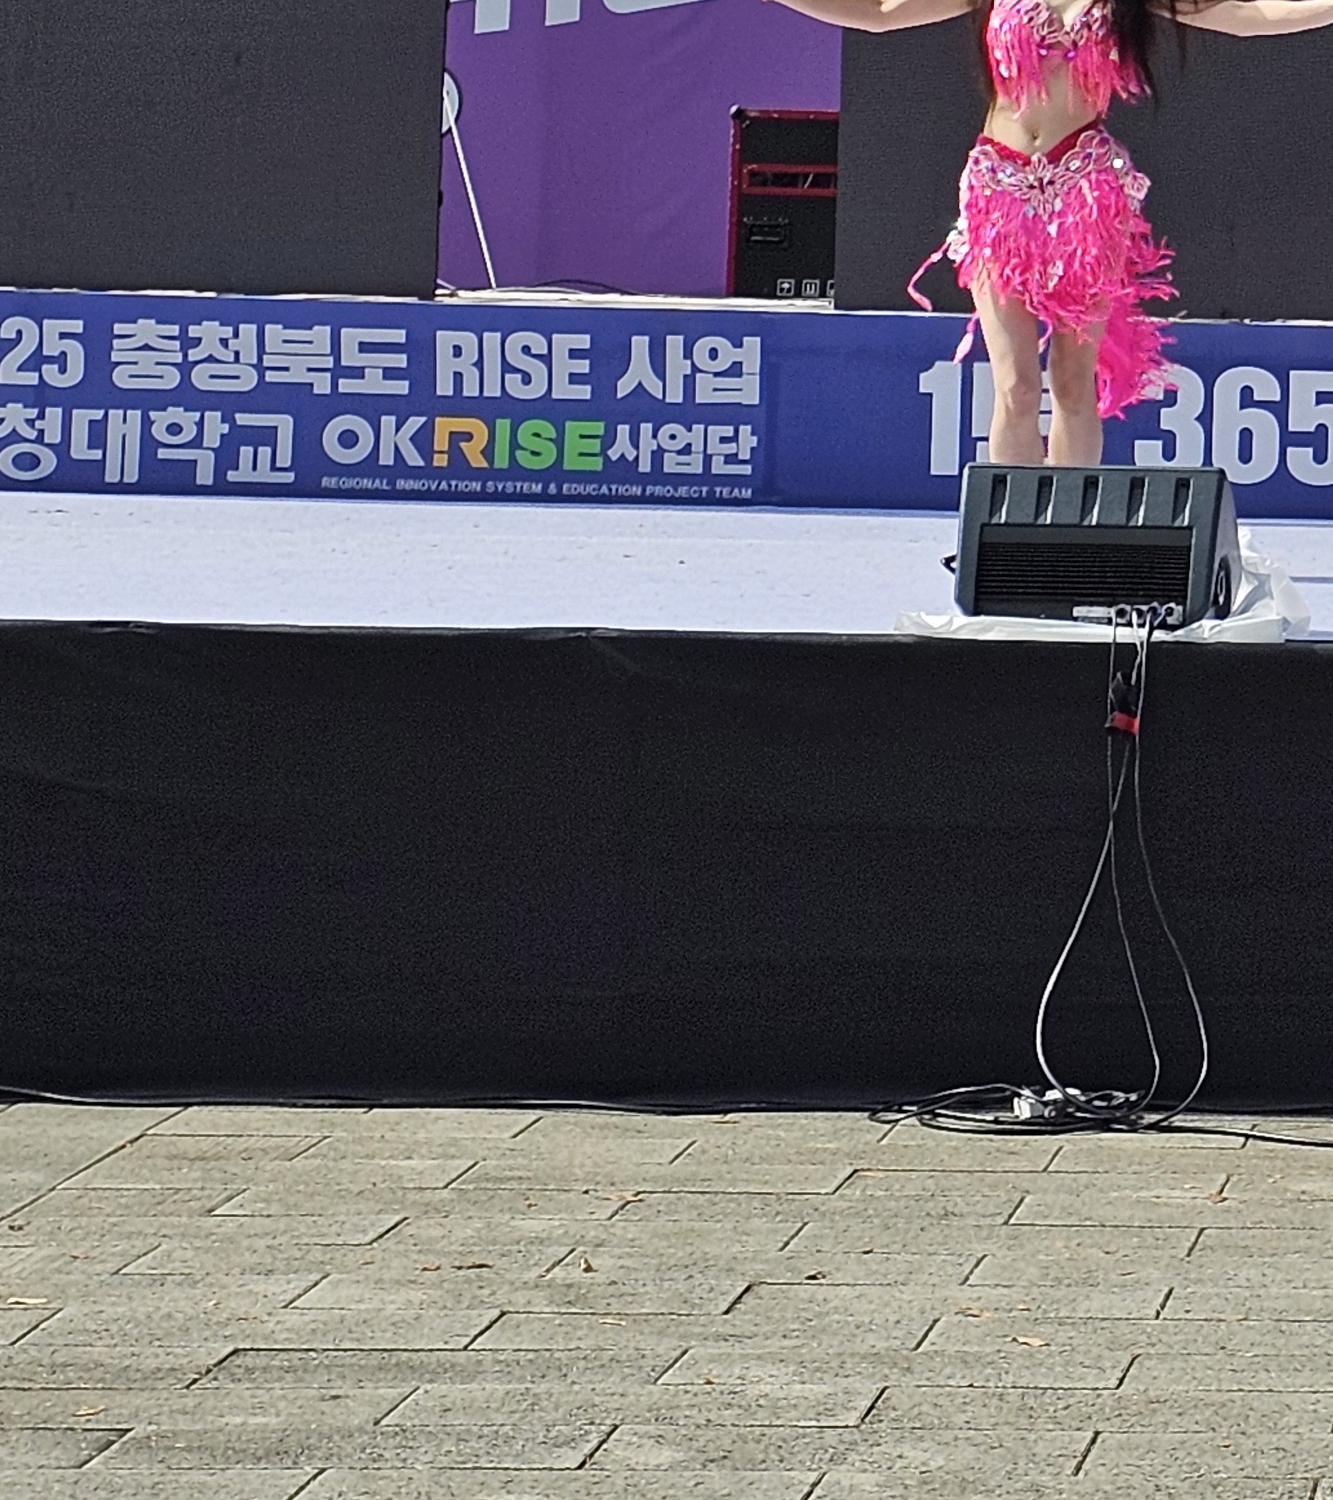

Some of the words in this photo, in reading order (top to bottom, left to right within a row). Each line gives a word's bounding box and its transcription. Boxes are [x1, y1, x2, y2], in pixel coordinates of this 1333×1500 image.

[0, 316, 85, 388] 25
[111, 318, 409, 394] 충청북도
[435, 330, 591, 400] RISE
[616, 335, 761, 404] 사업
[0, 403, 295, 486] 청대학교
[321, 476, 392, 490] REGIONAL
[396, 478, 481, 493] INNOVATION
[485, 480, 542, 494] SYSTEM
[547, 483, 558, 495] &
[562, 482, 642, 497] EDUCATION
[645, 484, 709, 498] PROJECT
[713, 486, 753, 499] TEAM
